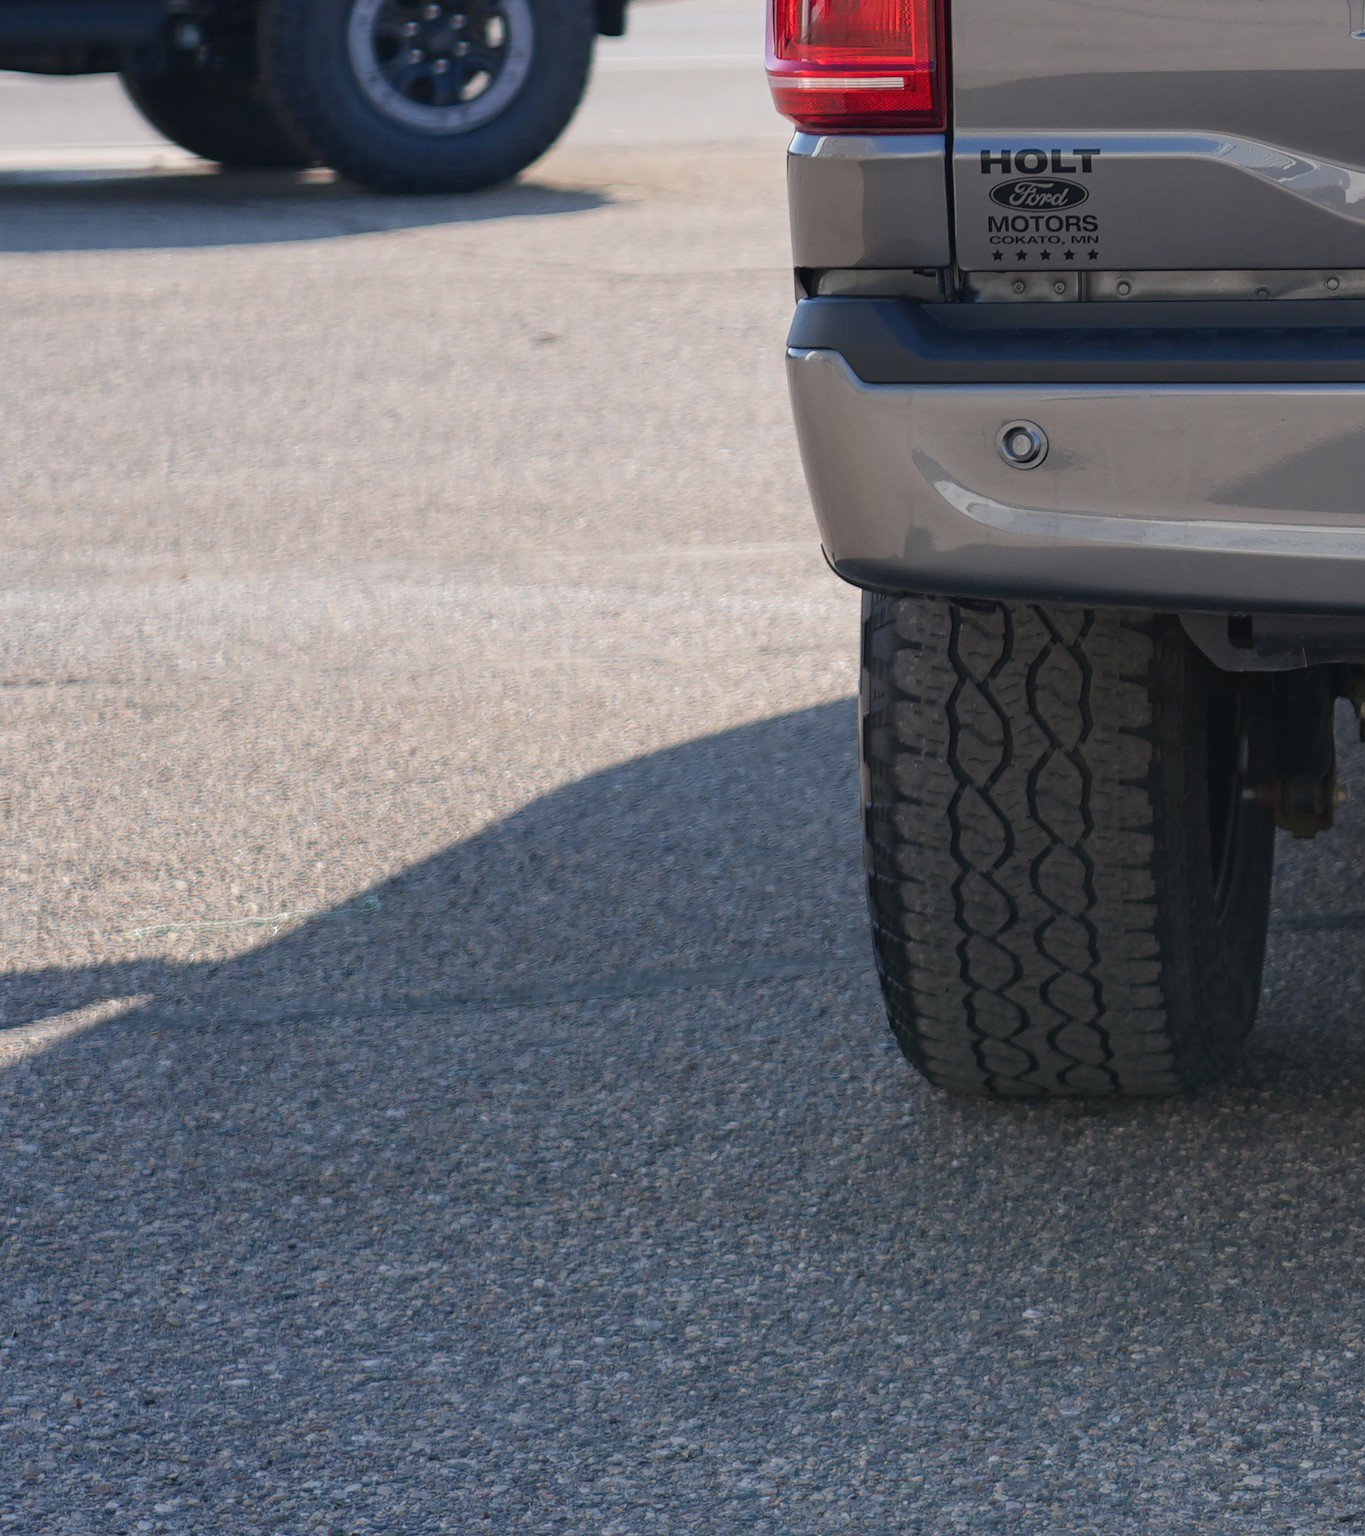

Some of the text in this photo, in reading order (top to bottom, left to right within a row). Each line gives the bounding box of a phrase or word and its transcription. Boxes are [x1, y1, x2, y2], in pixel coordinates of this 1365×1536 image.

[980, 148, 1101, 174] HOLT
[1009, 182, 1070, 206] Ford
[987, 214, 1099, 233] MOTORS
[989, 235, 1099, 246] COKATO, MN
